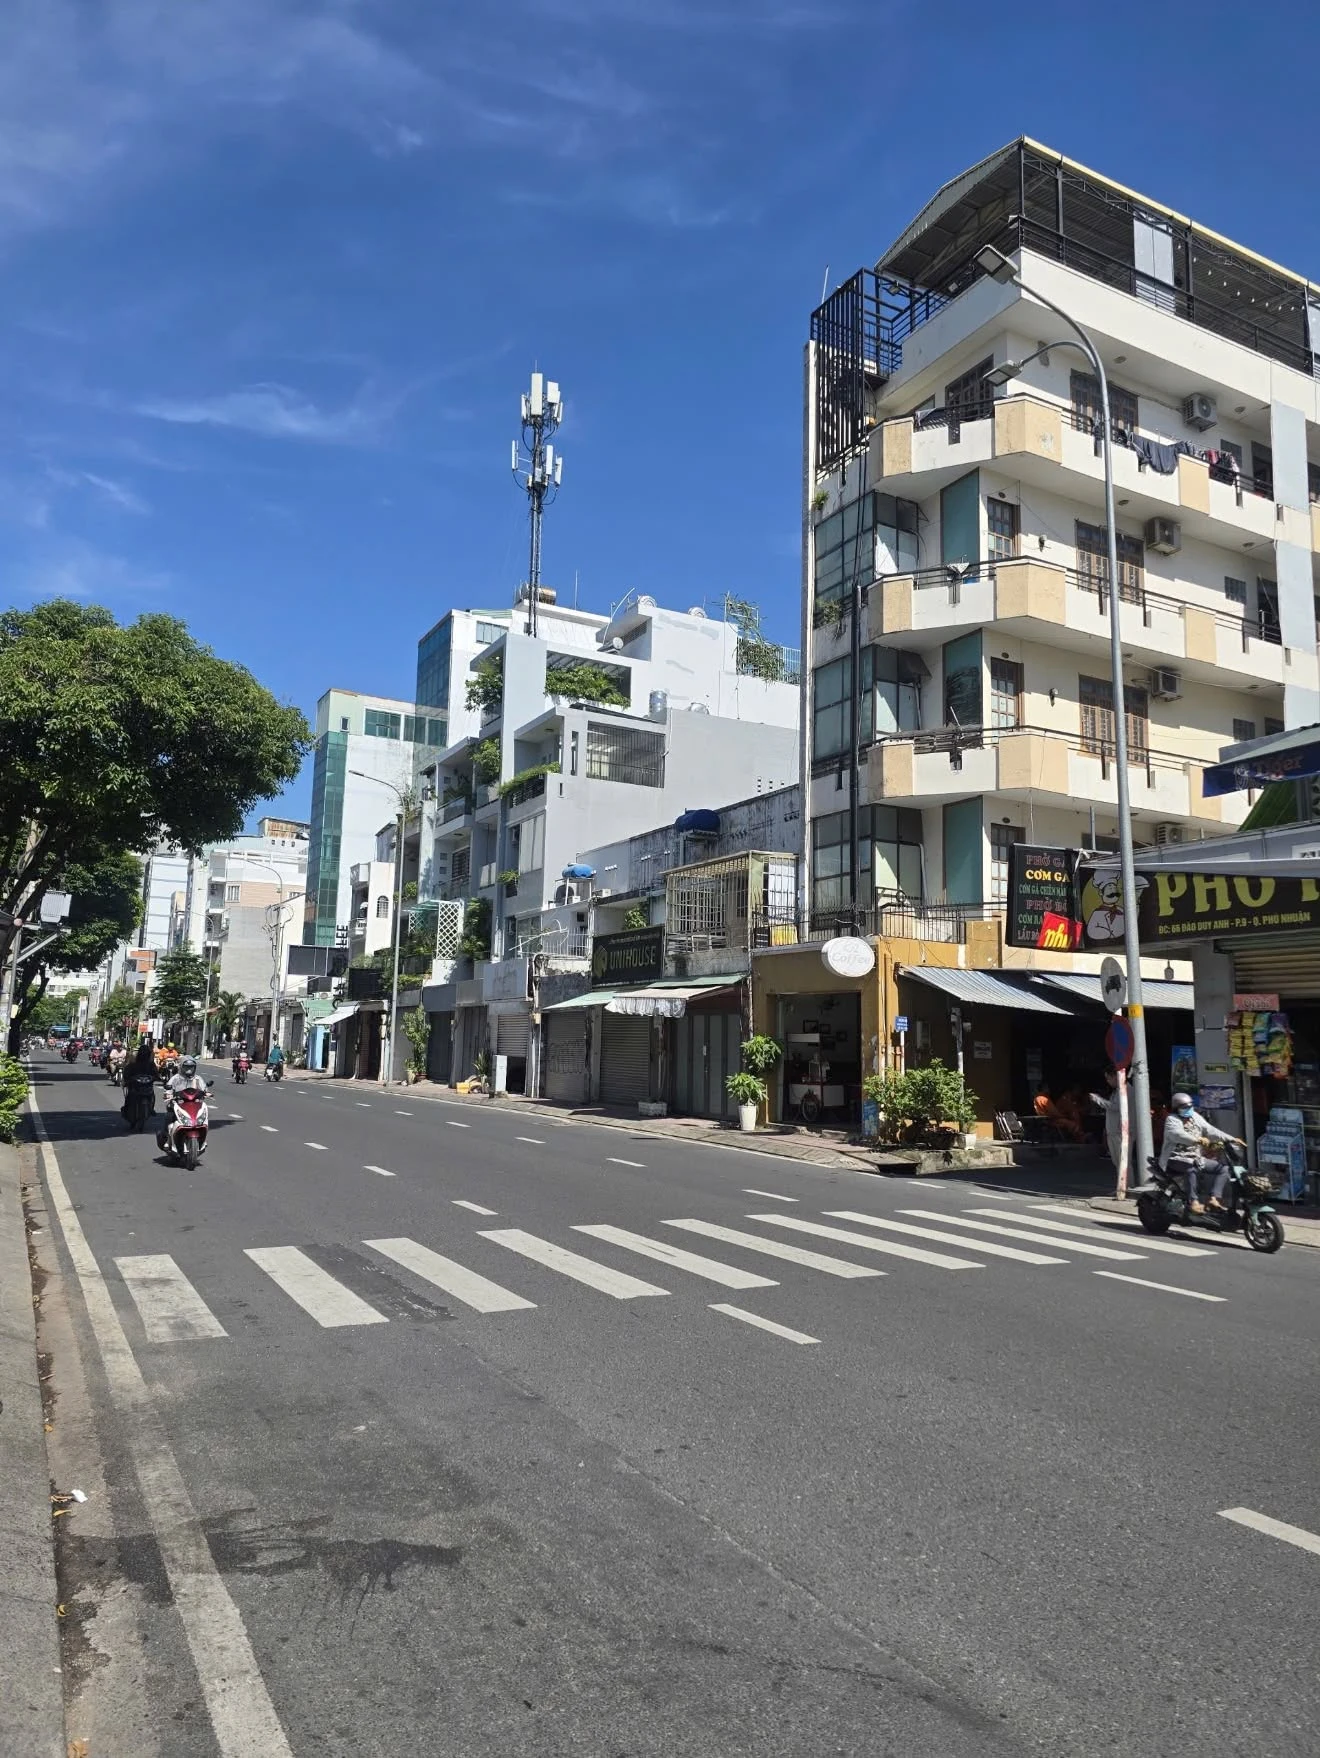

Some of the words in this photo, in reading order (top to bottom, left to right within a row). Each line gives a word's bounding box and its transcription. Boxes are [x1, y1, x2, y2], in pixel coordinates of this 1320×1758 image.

[1025, 869, 1052, 881] CƠM
[1197, 920, 1212, 931] DUY
[1213, 918, 1230, 930] ANH
[610, 945, 657, 970] UNIHOUSE
